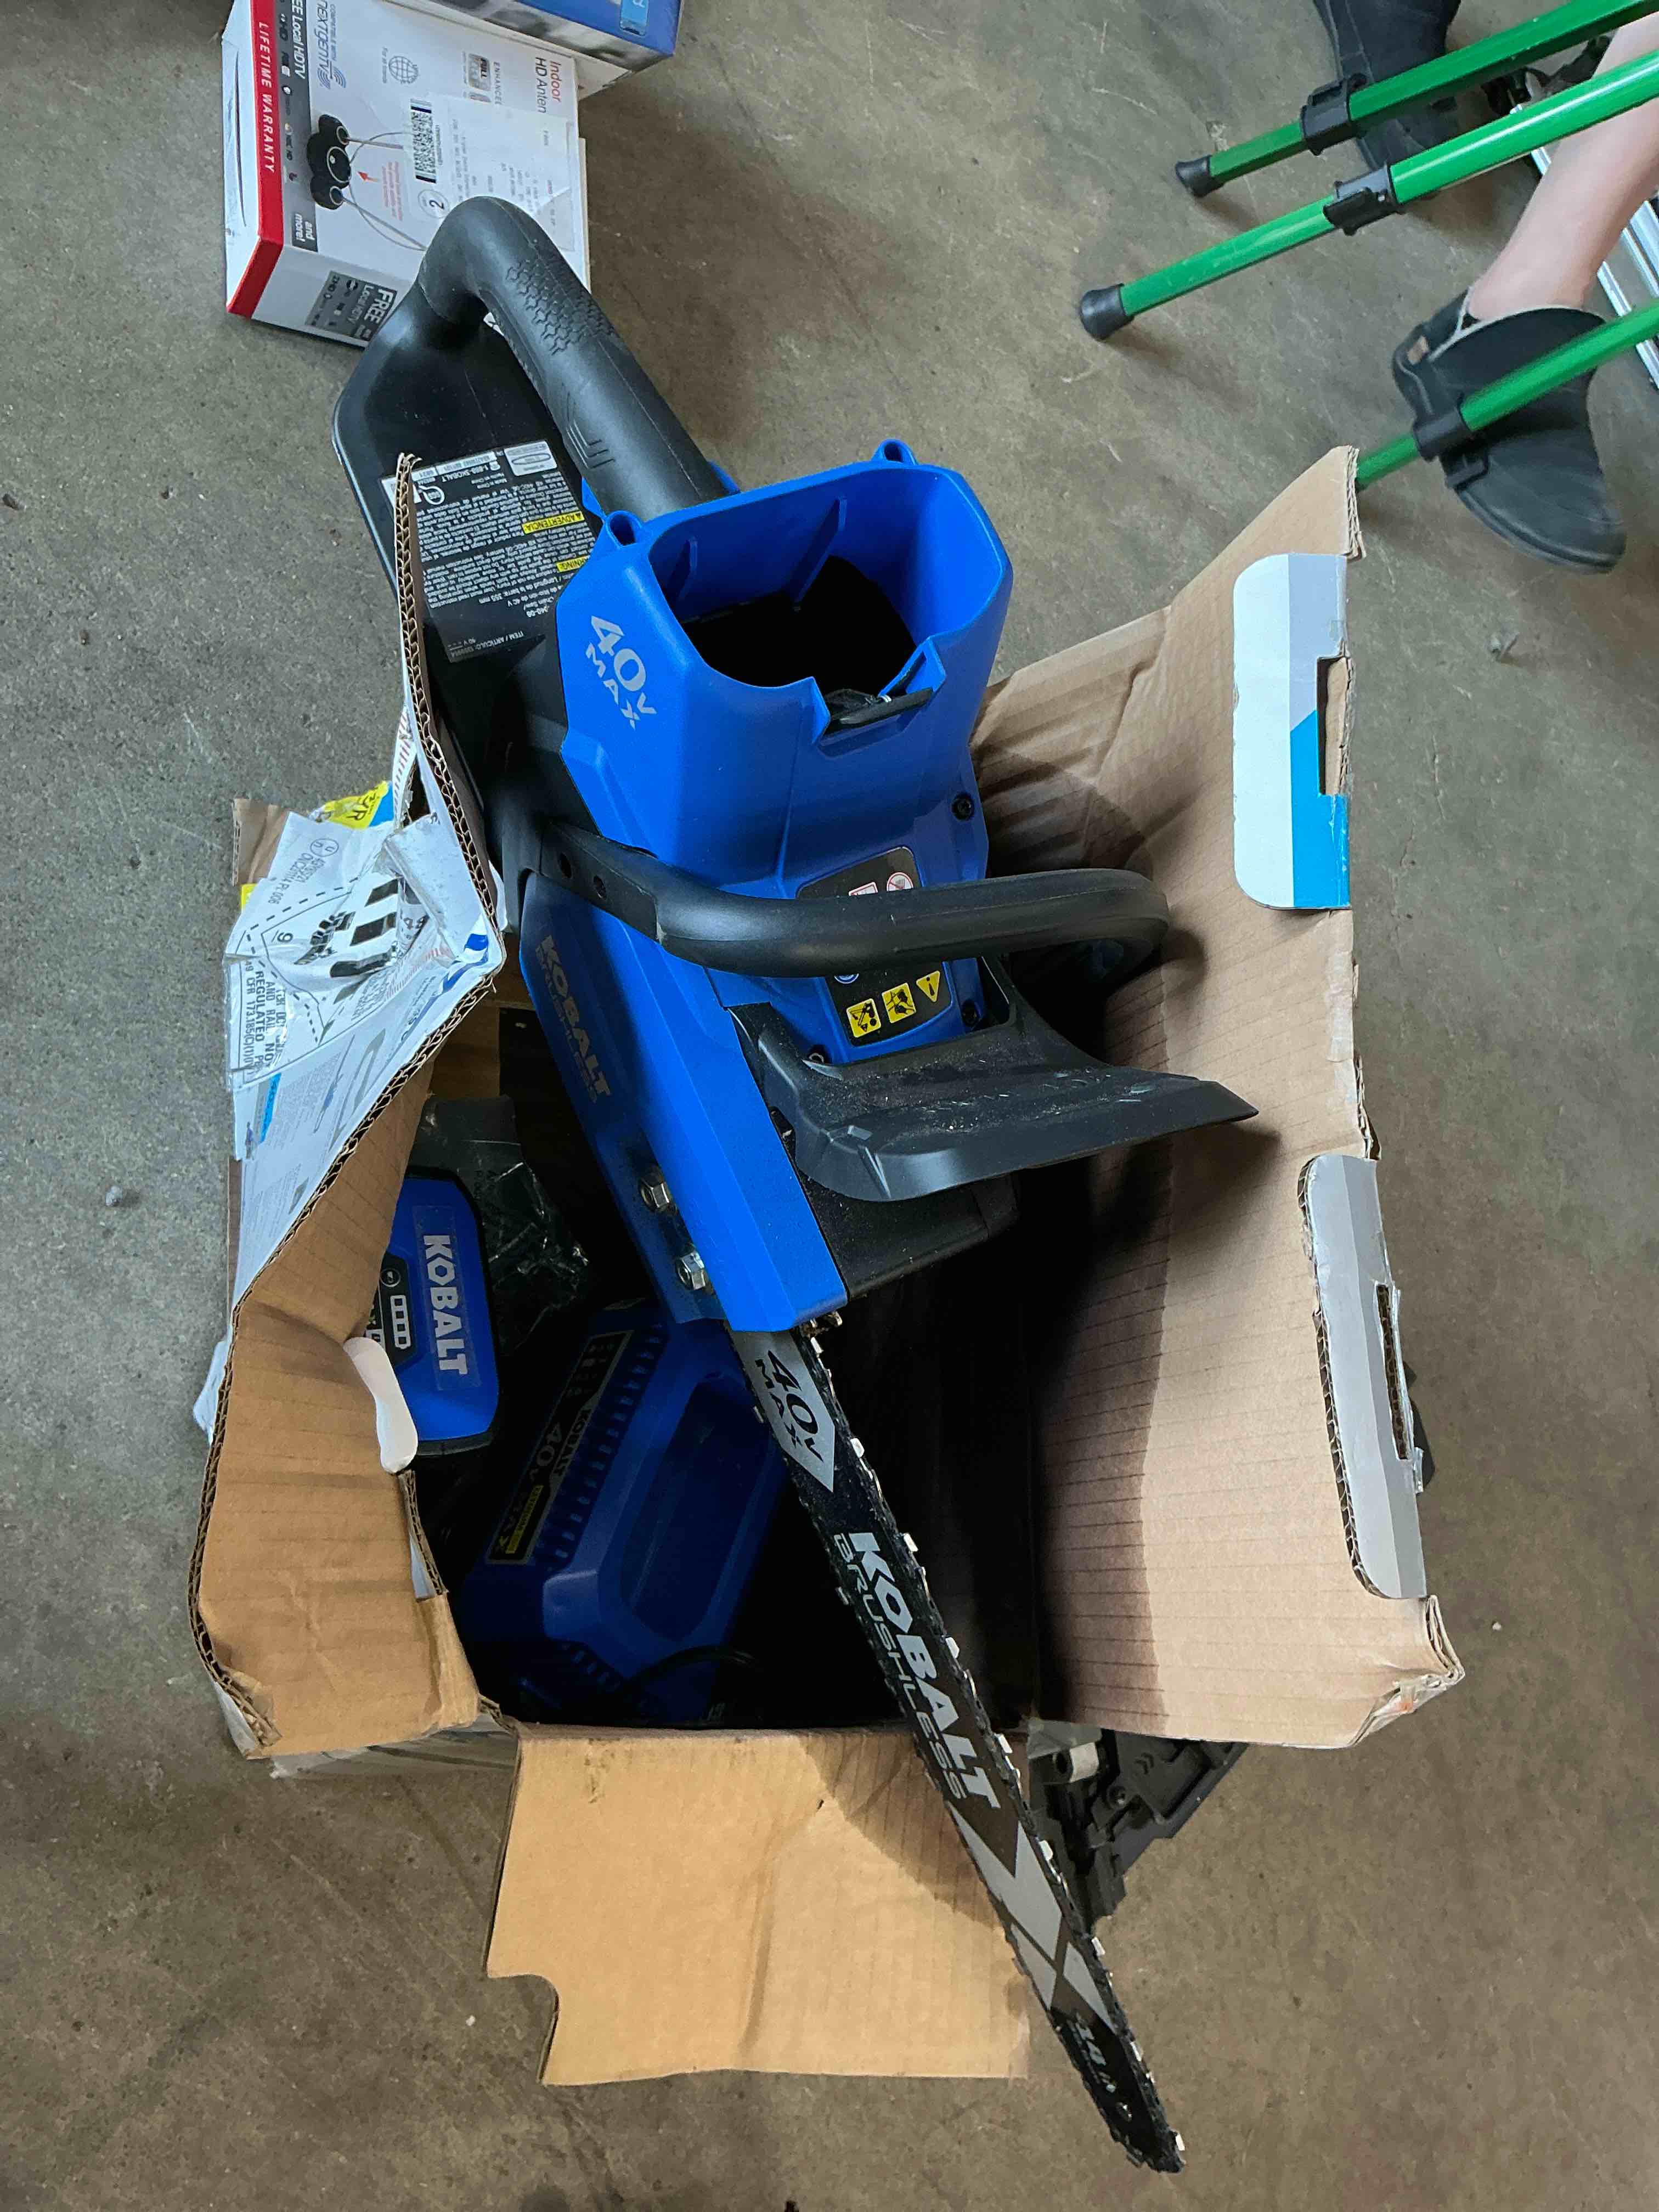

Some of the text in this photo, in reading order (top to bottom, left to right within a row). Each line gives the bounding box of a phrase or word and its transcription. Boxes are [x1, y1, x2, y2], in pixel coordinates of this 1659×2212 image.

[292, 15, 303, 45] Local
[293, 47, 304, 78] HDTV
[549, 61, 561, 101] Indoor
[258, 22, 274, 172] LIFETIME WARRANTY
[535, 57, 548, 113] HD Anten
[295, 214, 304, 242] more!
[304, 221, 314, 239] and
[363, 289, 393, 324] FREE
[478, 596, 490, 604] mm
[509, 630, 523, 640] ITEM
[585, 643, 640, 729] MAX
[276, 930, 294, 944] 9
[246, 978, 255, 994] CFR
[265, 981, 275, 1001] AND
[255, 970, 264, 1041] REGULATED
[541, 935, 612, 1096] KOBALT
[423, 1234, 468, 1375] KOBALT
[754, 1358, 802, 1448] MAX
[833, 1532, 967, 1800] BRUSHLESS
[849, 1532, 1001, 1808] KOBALT
